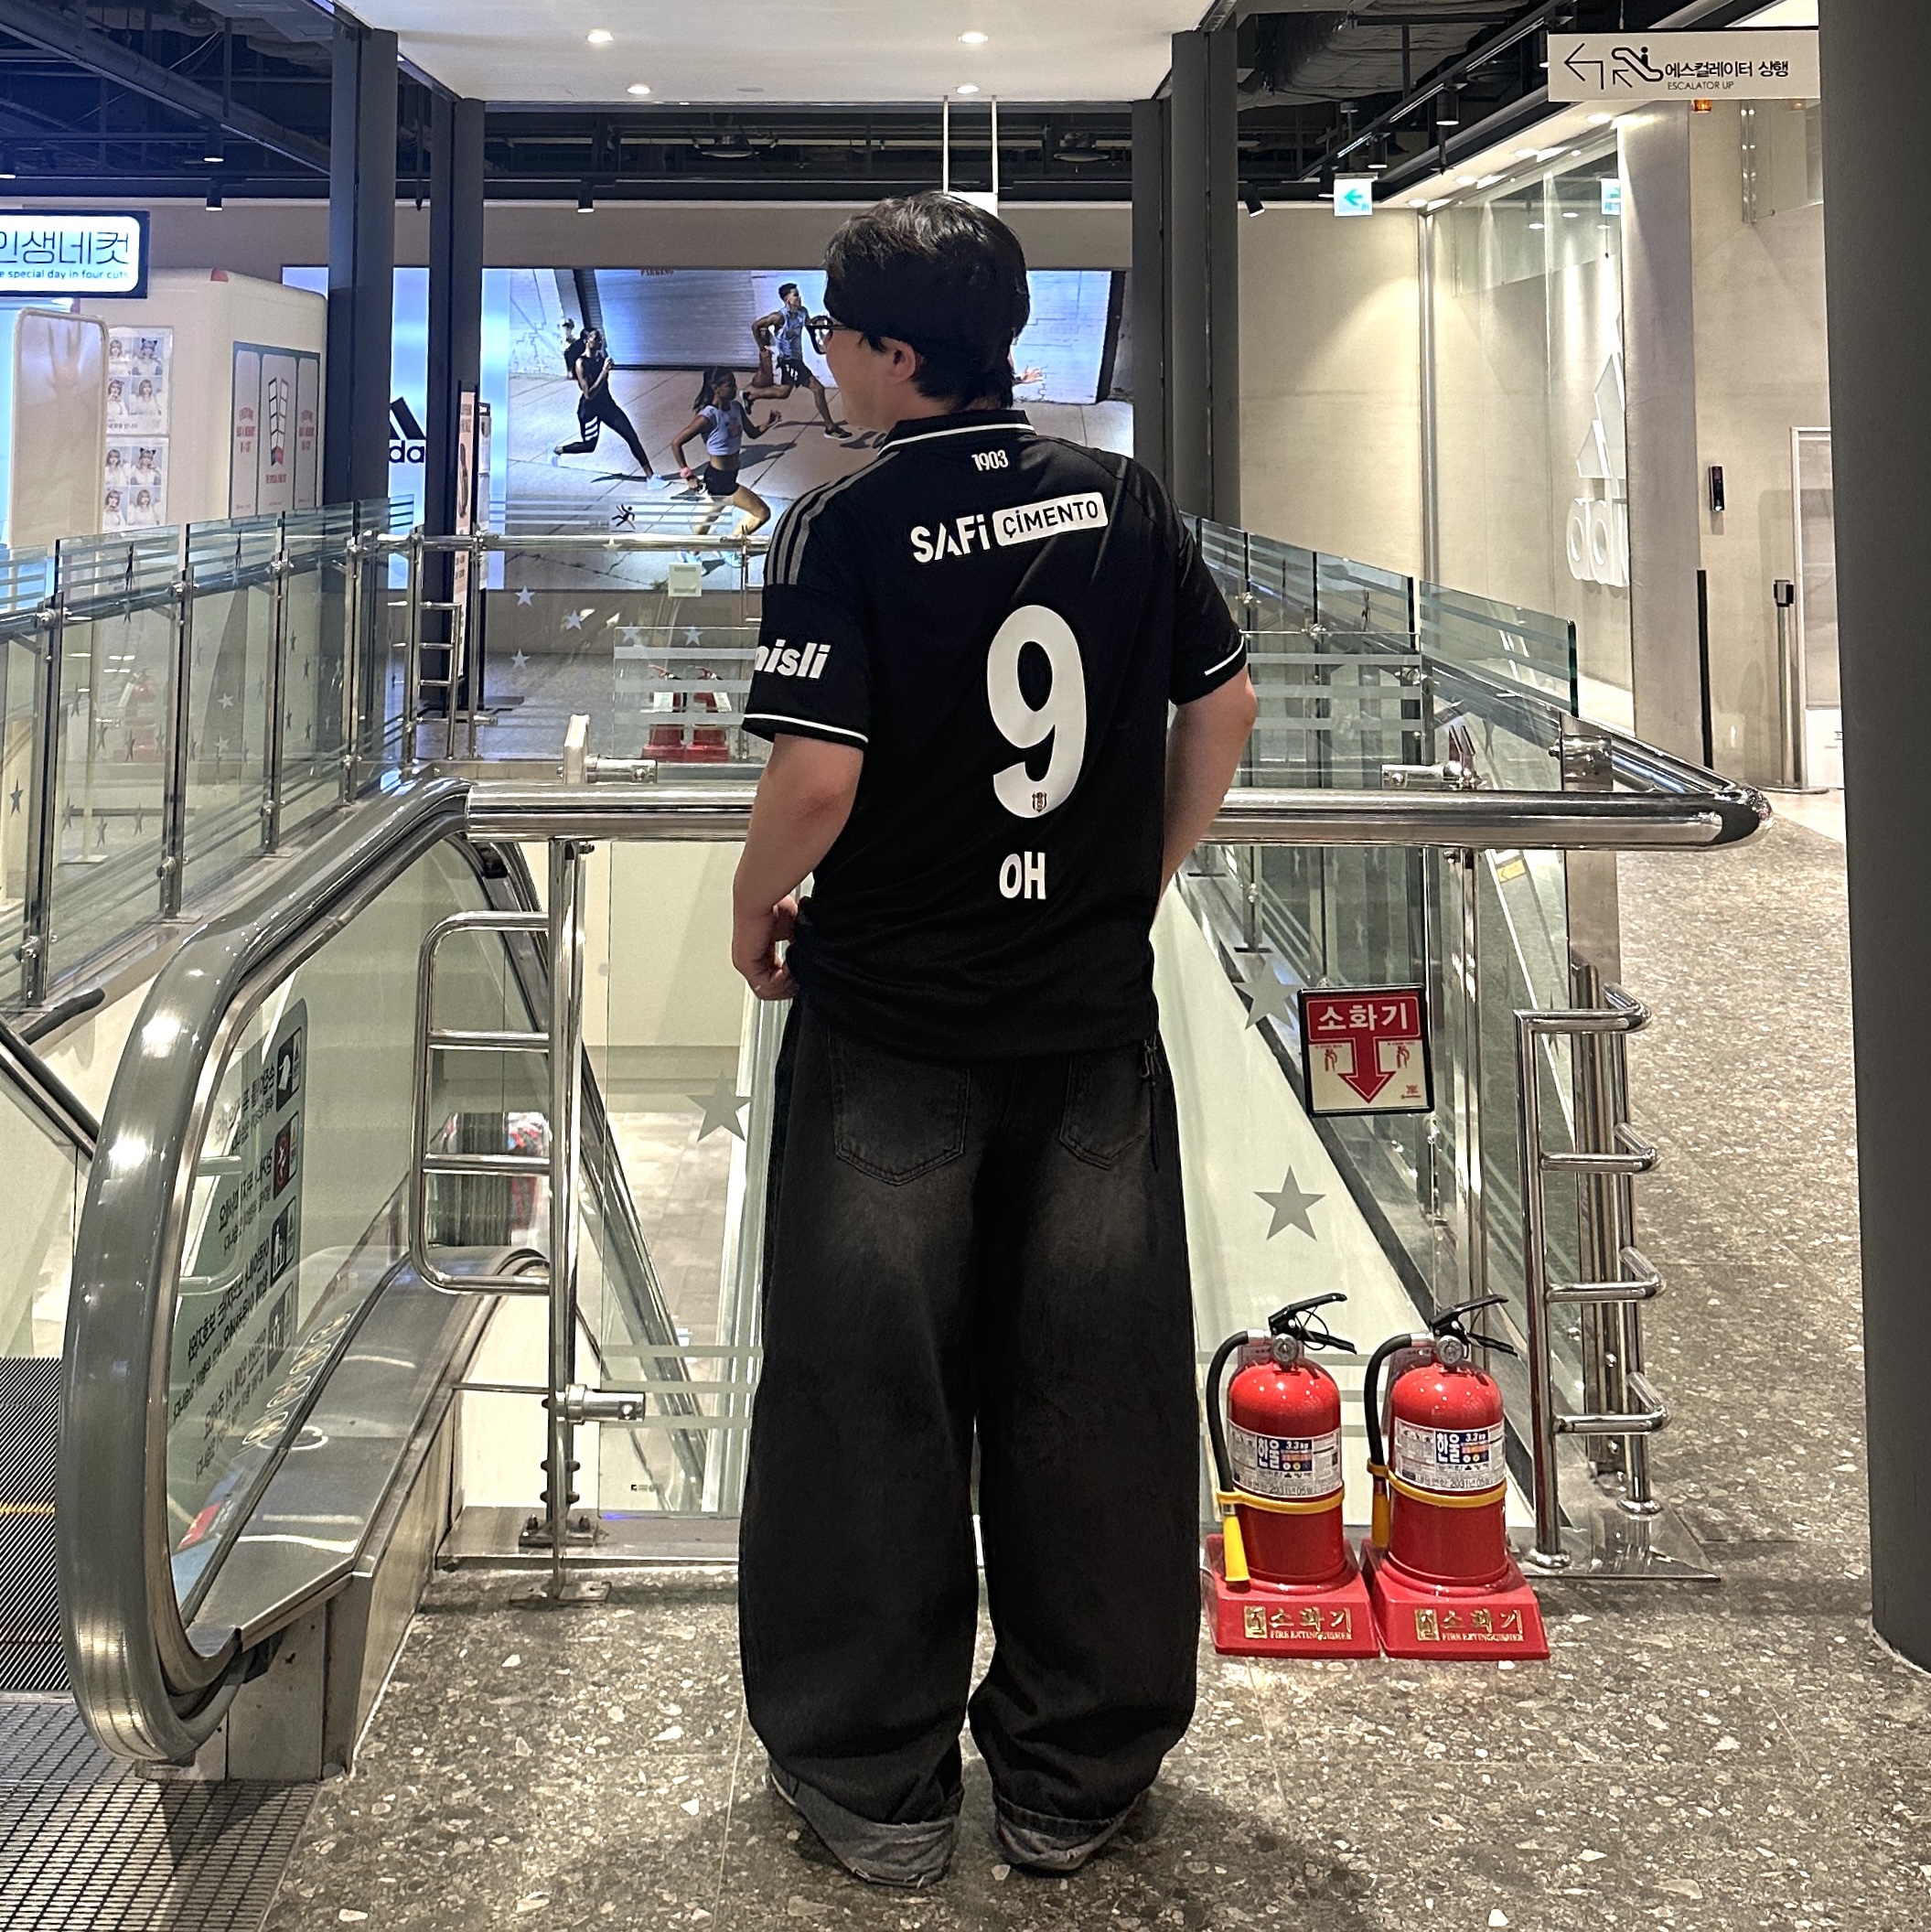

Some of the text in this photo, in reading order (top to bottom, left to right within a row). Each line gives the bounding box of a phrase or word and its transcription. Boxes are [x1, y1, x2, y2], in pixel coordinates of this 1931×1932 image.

[1665, 60, 1789, 78] 에스컬레이터 상행
[1668, 81, 1720, 90] ESCALATOR
[0, 231, 129, 264] 인생네컷
[8, 270, 44, 279] special
[48, 270, 65, 279] day
[70, 270, 79, 278] in
[82, 270, 102, 279] four
[107, 271, 129, 279] cuts
[971, 449, 1009, 472] 1903
[987, 605, 1087, 818] 9
[999, 851, 1046, 900] OH
[1317, 1003, 1408, 1031] 소화기
[1258, 1438, 1280, 1469] 한울
[1437, 1433, 1460, 1464] 한울
[1270, 1606, 1352, 1633] 소화기
[1441, 1608, 1523, 1635] 소화기
